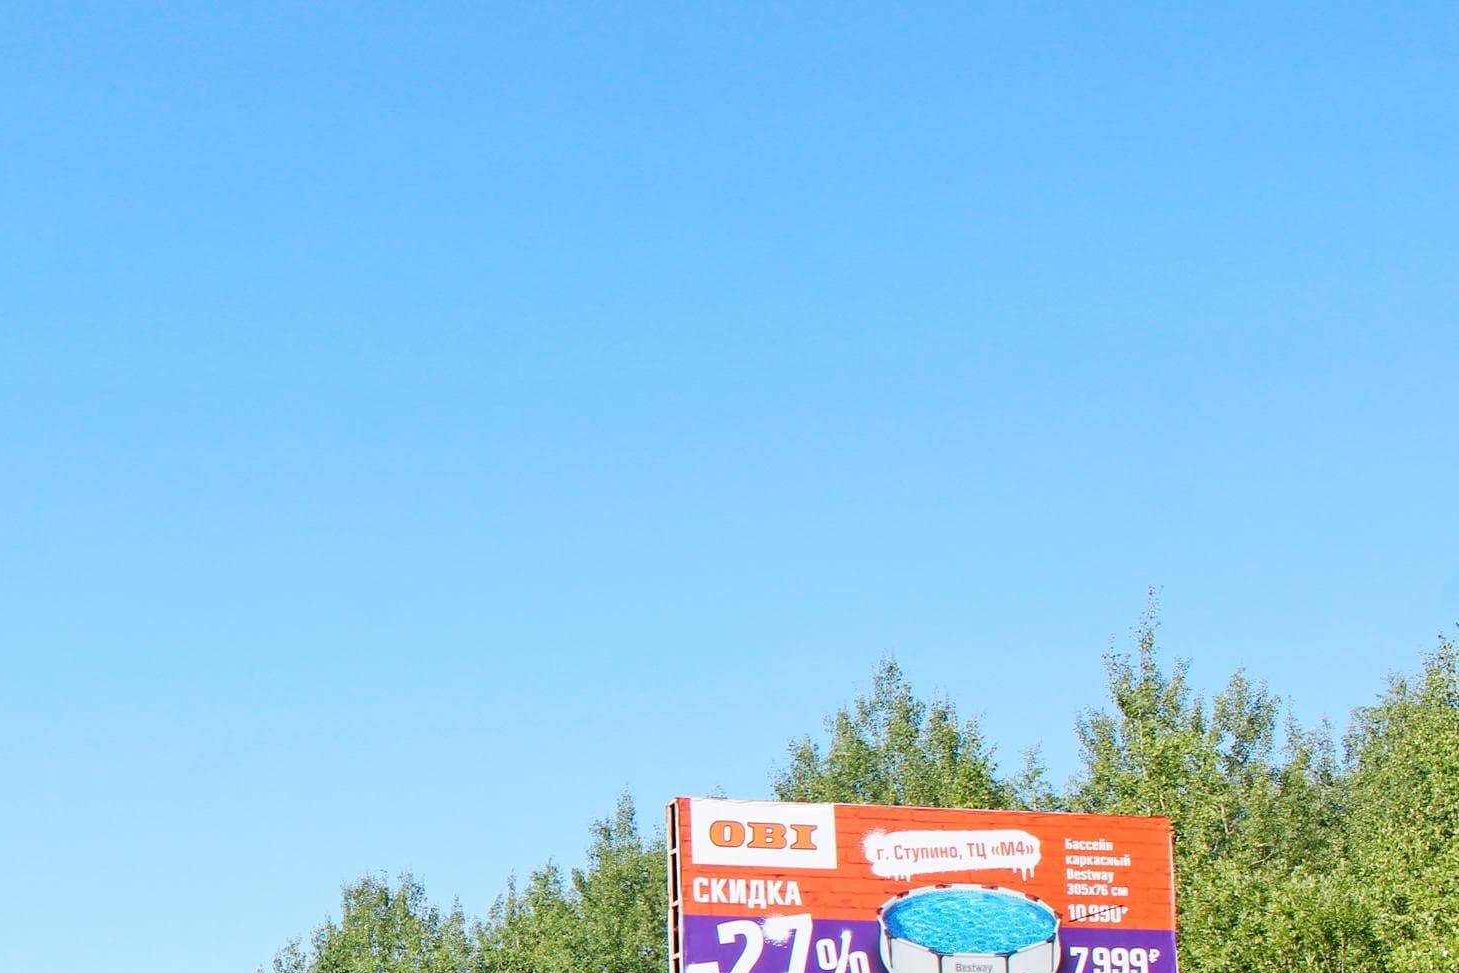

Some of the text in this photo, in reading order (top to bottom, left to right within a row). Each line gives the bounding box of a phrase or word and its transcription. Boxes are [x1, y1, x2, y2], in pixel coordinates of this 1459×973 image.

[709, 820, 818, 850] OBI
[1064, 838, 1113, 851] Бассейн
[876, 848, 889, 860] г.
[894, 845, 963, 863] Ступино,
[966, 842, 987, 859] ТЦ
[1065, 854, 1131, 867] каркасный
[1066, 868, 1114, 883] Bestway
[693, 877, 802, 909] СКИДКА
[1111, 886, 1128, 896] см
